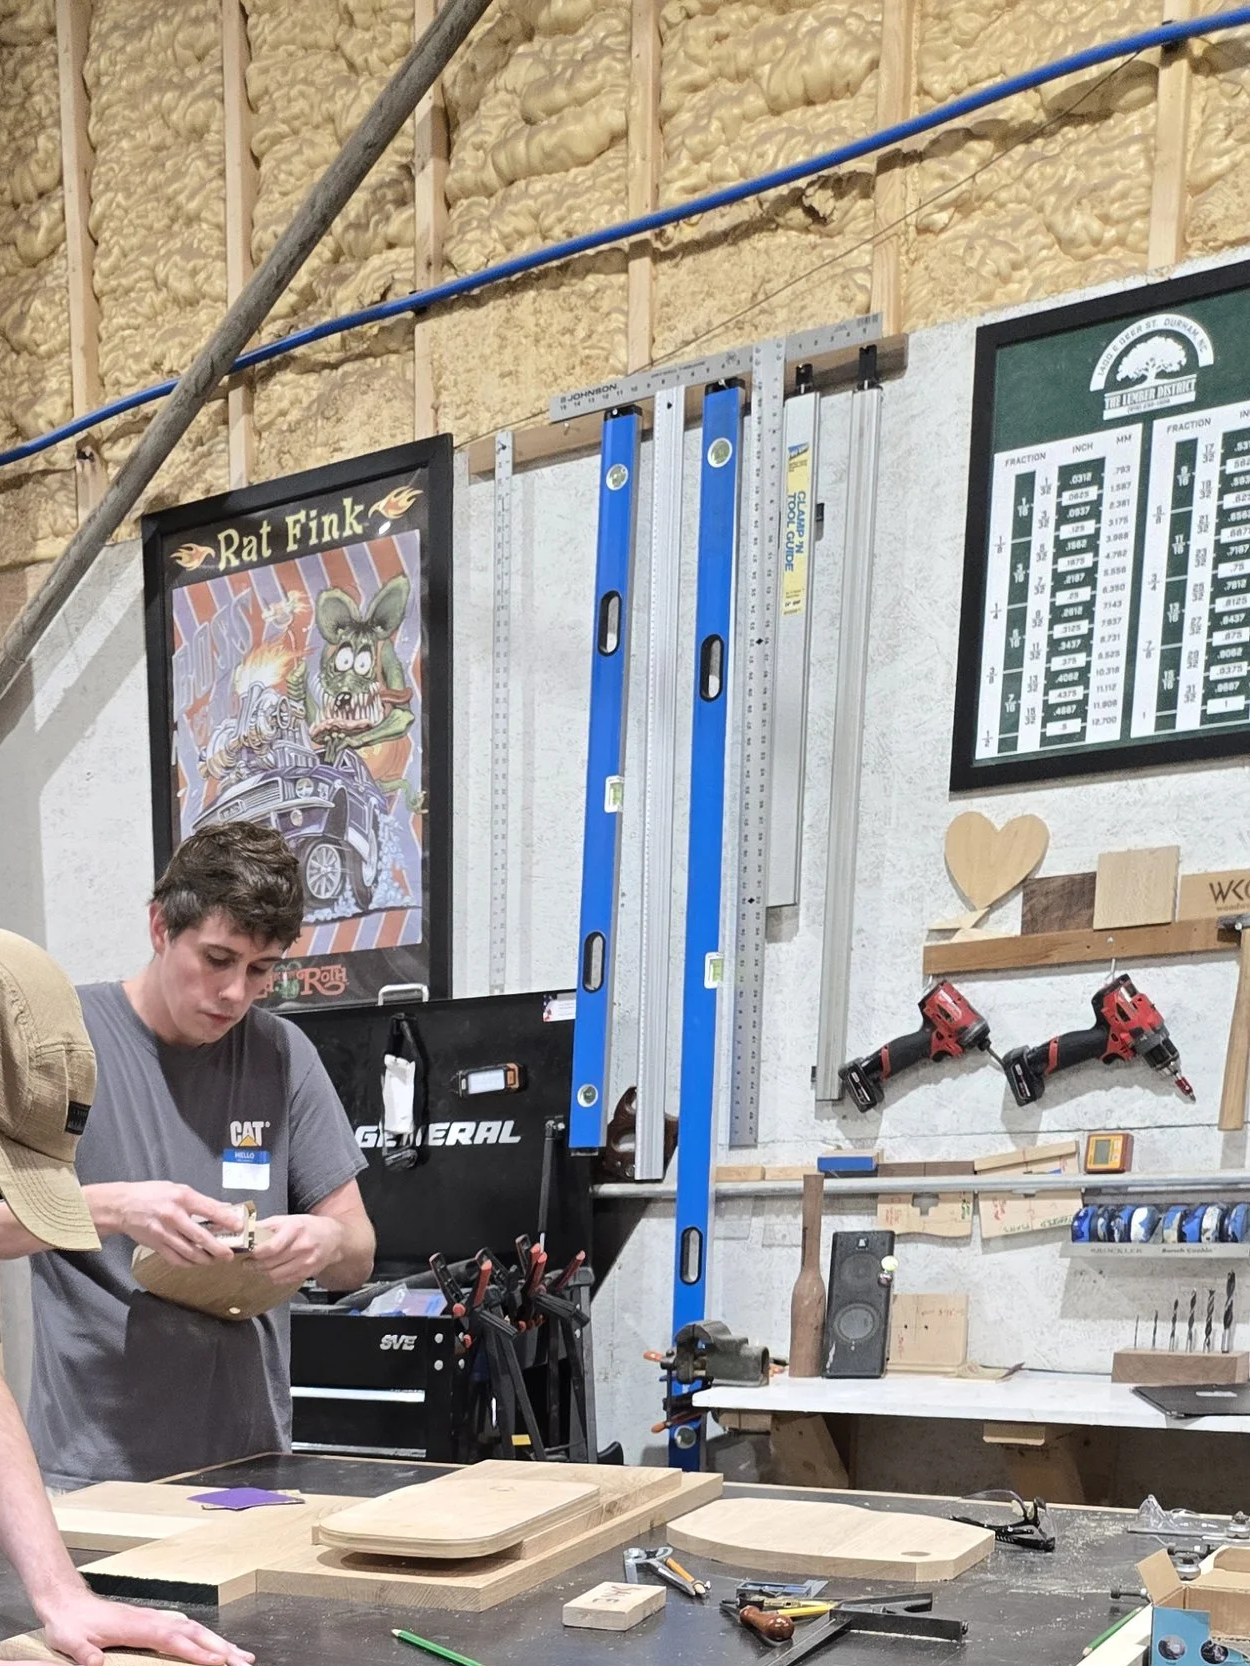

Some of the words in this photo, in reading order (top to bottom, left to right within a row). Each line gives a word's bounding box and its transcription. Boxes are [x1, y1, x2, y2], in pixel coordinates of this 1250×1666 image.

[567, 383, 618, 402] JOHNSON
[1156, 380, 1196, 399] DISTRICT
[1166, 418, 1212, 433] FRACTION
[1005, 452, 1047, 467] FRACTION
[1072, 442, 1094, 454] INCH
[1116, 434, 1132, 445] MM
[787, 492, 797, 528] TOOL
[797, 490, 806, 537] CLAMP
[217, 524, 271, 571] Rat
[285, 497, 366, 553] Fink
[785, 531, 795, 572] GUIDE
[230, 1121, 265, 1147] CAT
[379, 1334, 418, 1351] SVE
